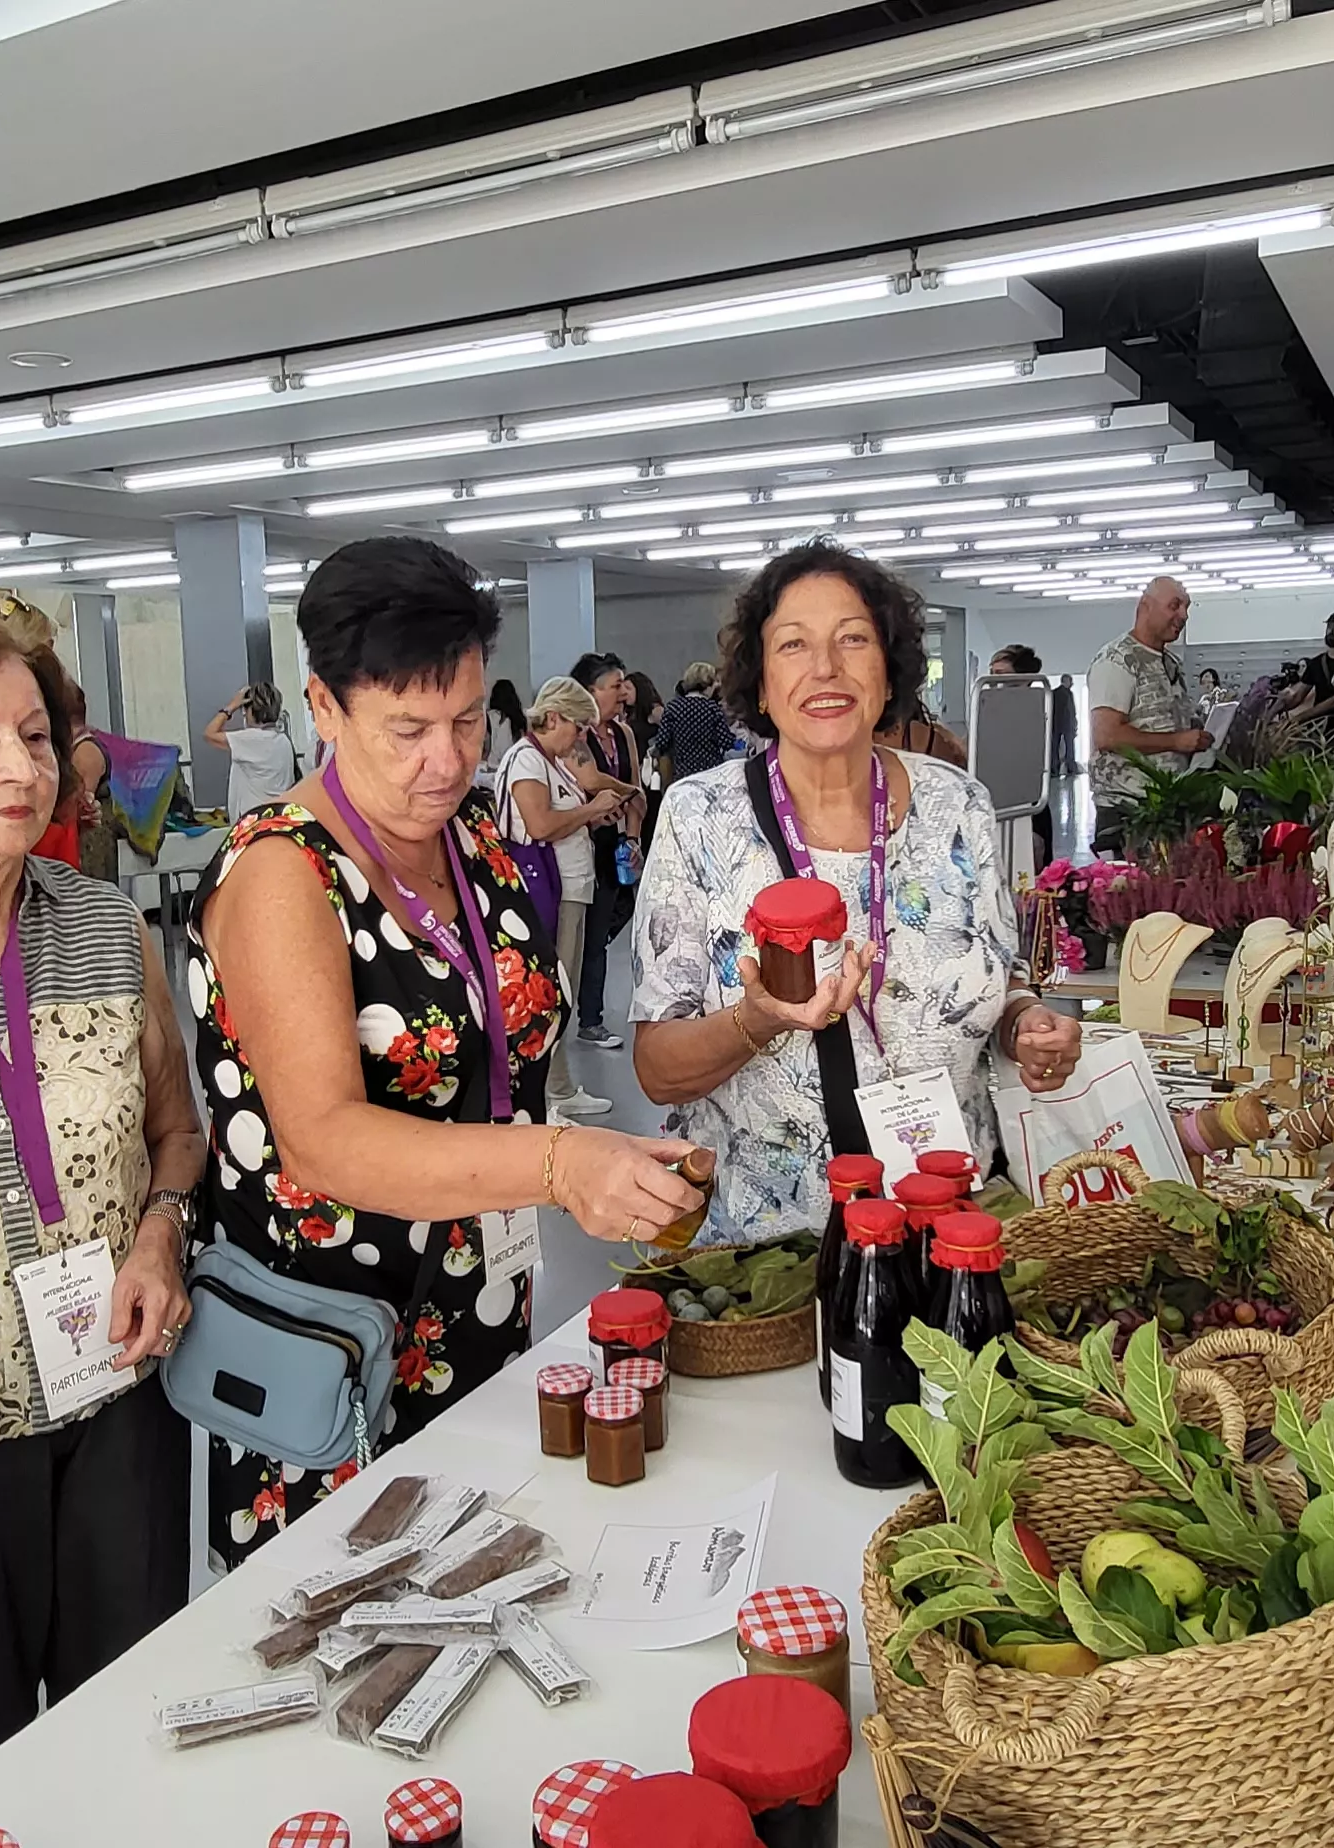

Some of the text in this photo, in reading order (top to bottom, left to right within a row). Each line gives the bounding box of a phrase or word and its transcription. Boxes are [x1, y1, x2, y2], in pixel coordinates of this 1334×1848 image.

[489, 1233, 535, 1268] PARTICIPANTE
[43, 1275, 93, 1299] INTERNACIONAL
[69, 1289, 82, 1300] LAS
